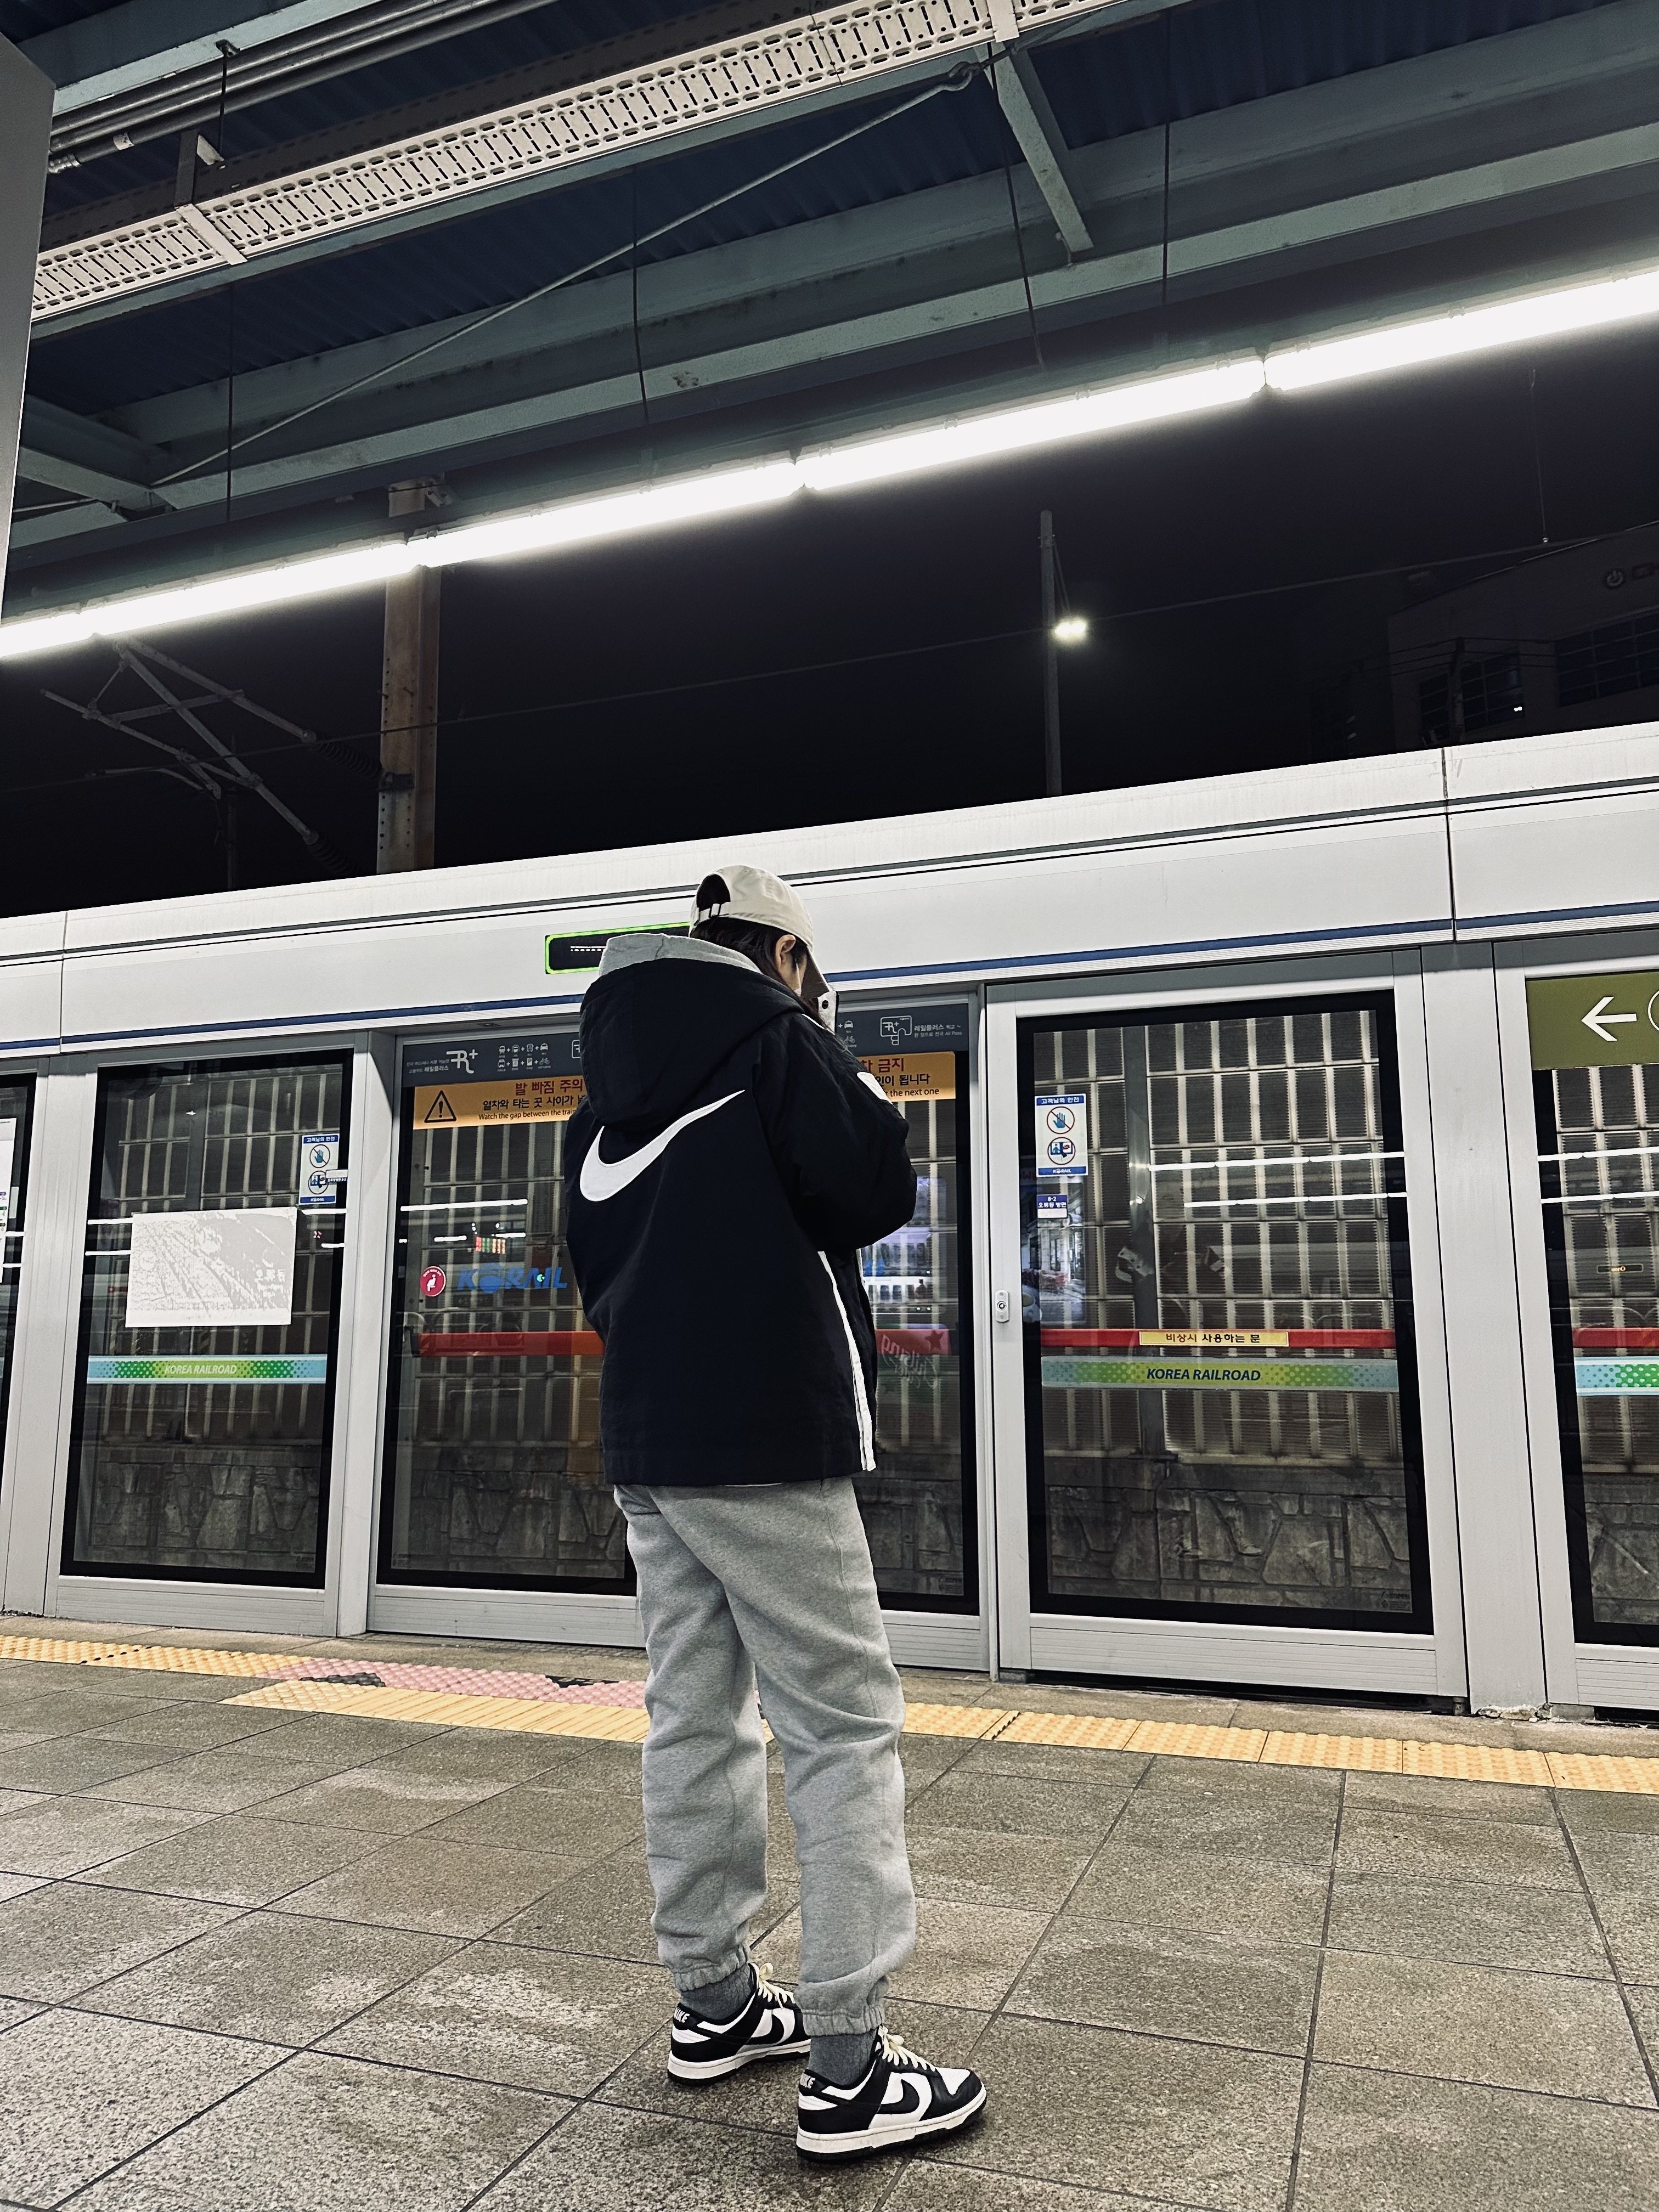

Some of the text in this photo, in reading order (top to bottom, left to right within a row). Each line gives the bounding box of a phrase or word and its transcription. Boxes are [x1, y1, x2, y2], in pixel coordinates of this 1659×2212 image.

[878, 1058, 904, 1073] 금지
[899, 1073, 930, 1086] 됩니다
[515, 1079, 583, 1096] 발 빠짐 주의
[890, 1089, 903, 1097] the
[483, 1099, 510, 1111] 열차와
[512, 1098, 530, 1109] 타는
[546, 1095, 574, 1107] 사이가
[478, 1111, 498, 1120] Watch
[499, 1111, 509, 1119] the
[510, 1112, 521, 1120] gap
[523, 1110, 549, 1118] between
[1166, 1333, 1260, 1344] 비상시 사용하는 문
[165, 1364, 237, 1374] KOREA RAILROAD
[1147, 1368, 1261, 1381] KOREA RAILROAD
